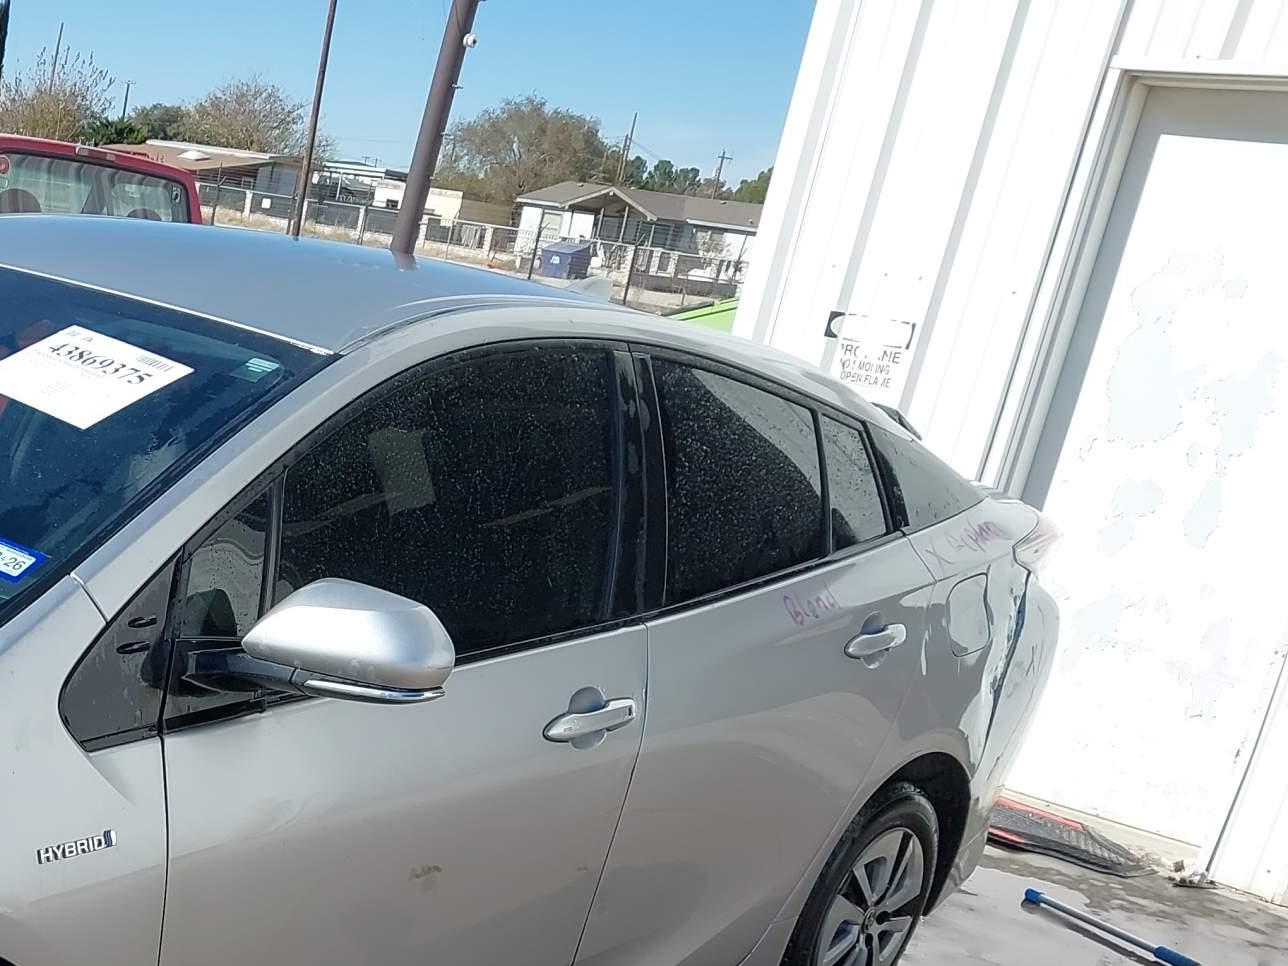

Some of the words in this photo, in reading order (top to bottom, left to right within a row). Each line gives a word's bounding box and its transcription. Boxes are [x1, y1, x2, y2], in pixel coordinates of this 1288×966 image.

[49, 343, 154, 384] 43869375
[840, 370, 863, 383] OPEN
[37, 835, 106, 864] HYBRID
